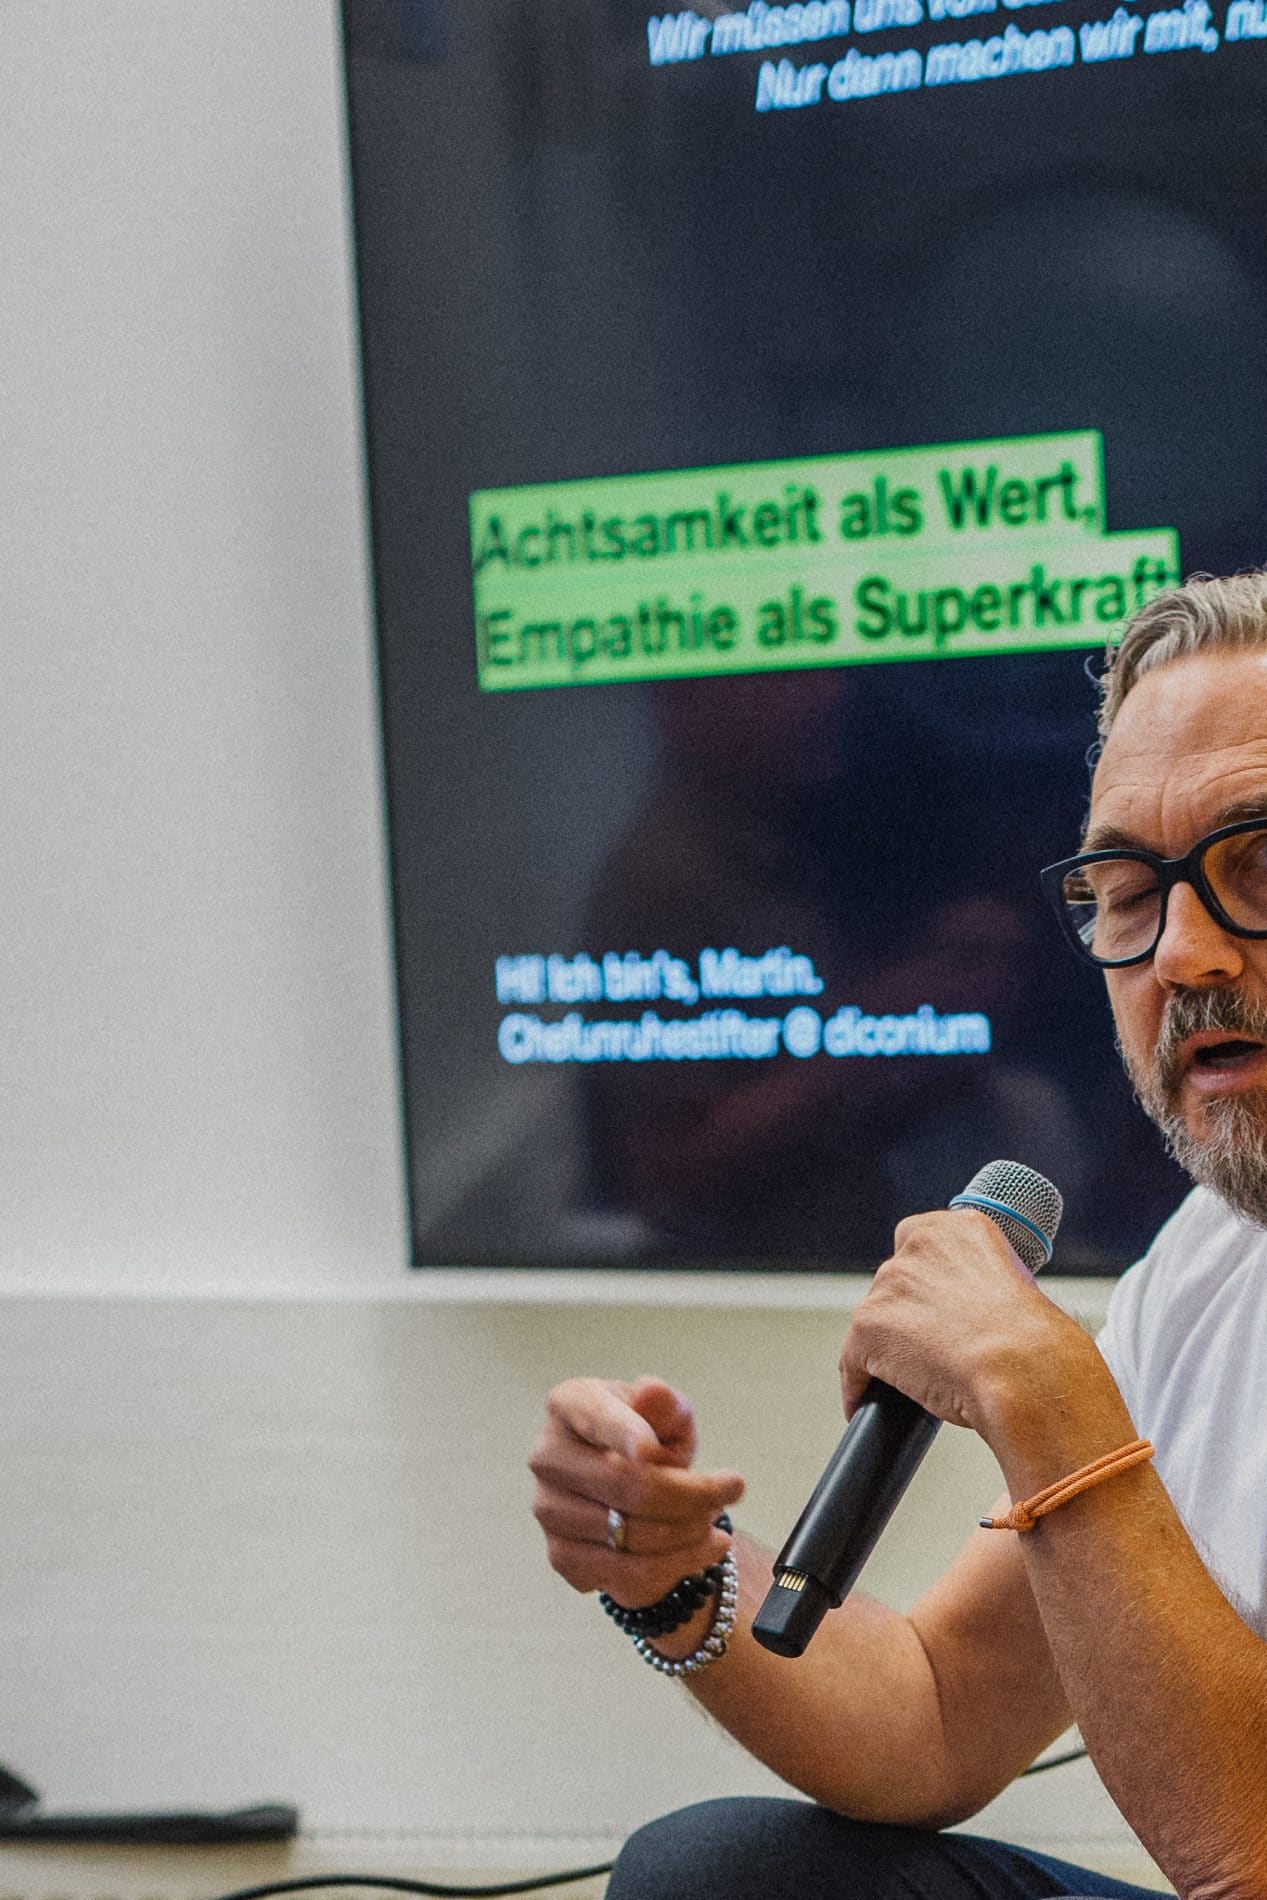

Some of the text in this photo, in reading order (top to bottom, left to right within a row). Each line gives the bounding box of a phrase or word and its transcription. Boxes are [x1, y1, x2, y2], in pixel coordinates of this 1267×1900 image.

[647, 10, 713, 66] Wir
[711, 0, 851, 57] müssen
[853, 0, 924, 33] uns
[755, 58, 829, 112] Nur
[827, 48, 923, 102] dann
[925, 22, 1075, 86] machen
[1079, 6, 1144, 64] wir
[1143, 0, 1219, 53] mit,
[477, 461, 1097, 570] Achtsamkeit als Wert,
[480, 592, 739, 673] Empathie
[754, 585, 838, 649] als
[547, 951, 601, 1003] Ich
[823, 1003, 992, 1058] diconium
